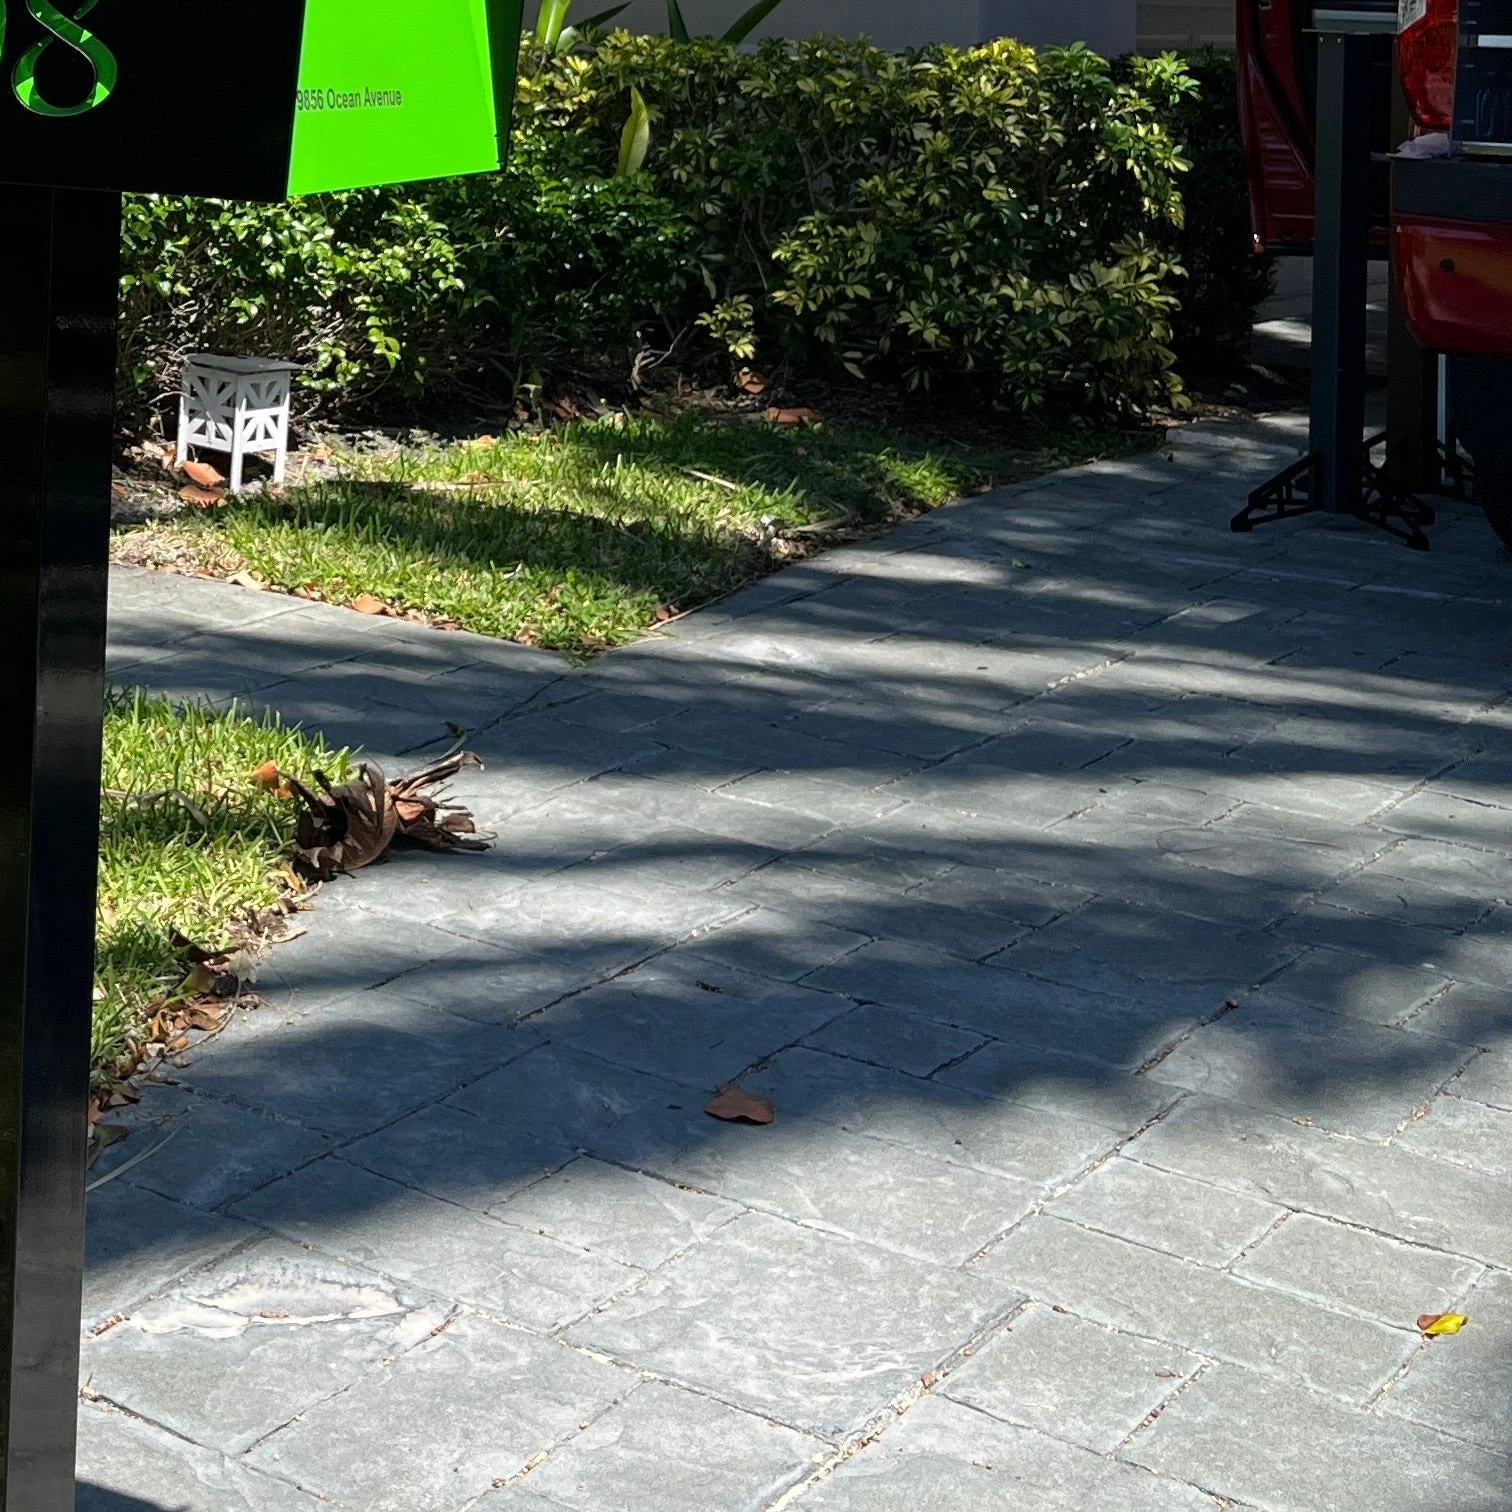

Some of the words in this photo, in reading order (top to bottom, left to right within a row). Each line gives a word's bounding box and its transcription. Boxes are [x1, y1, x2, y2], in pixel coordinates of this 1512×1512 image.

[296, 88, 324, 111] 9856
[326, 88, 361, 109] Ocean
[364, 86, 402, 107] Avenue
